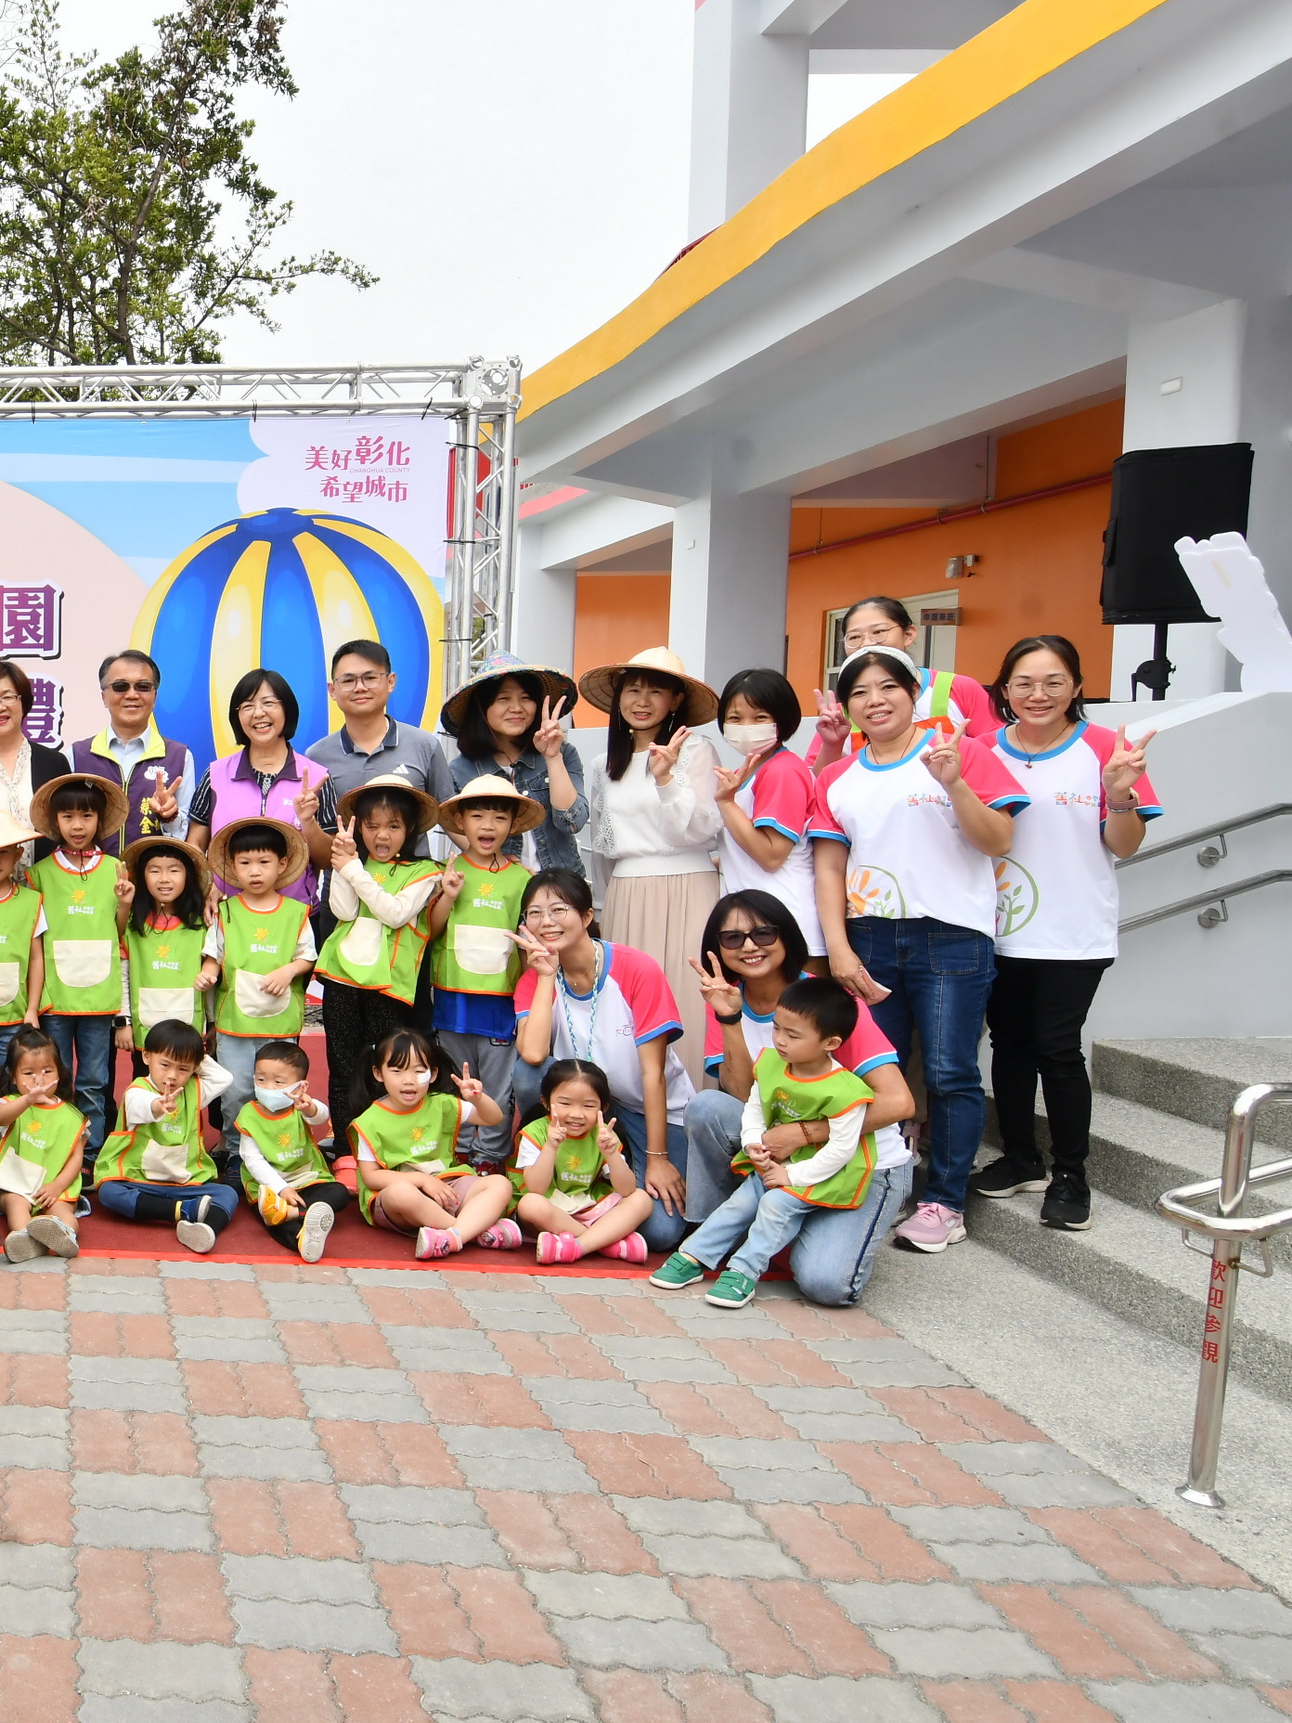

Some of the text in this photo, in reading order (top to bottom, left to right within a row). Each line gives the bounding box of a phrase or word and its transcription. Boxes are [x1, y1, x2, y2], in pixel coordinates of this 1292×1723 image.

[305, 435, 410, 470] 美好彰化
[320, 475, 408, 503] 希望城市
